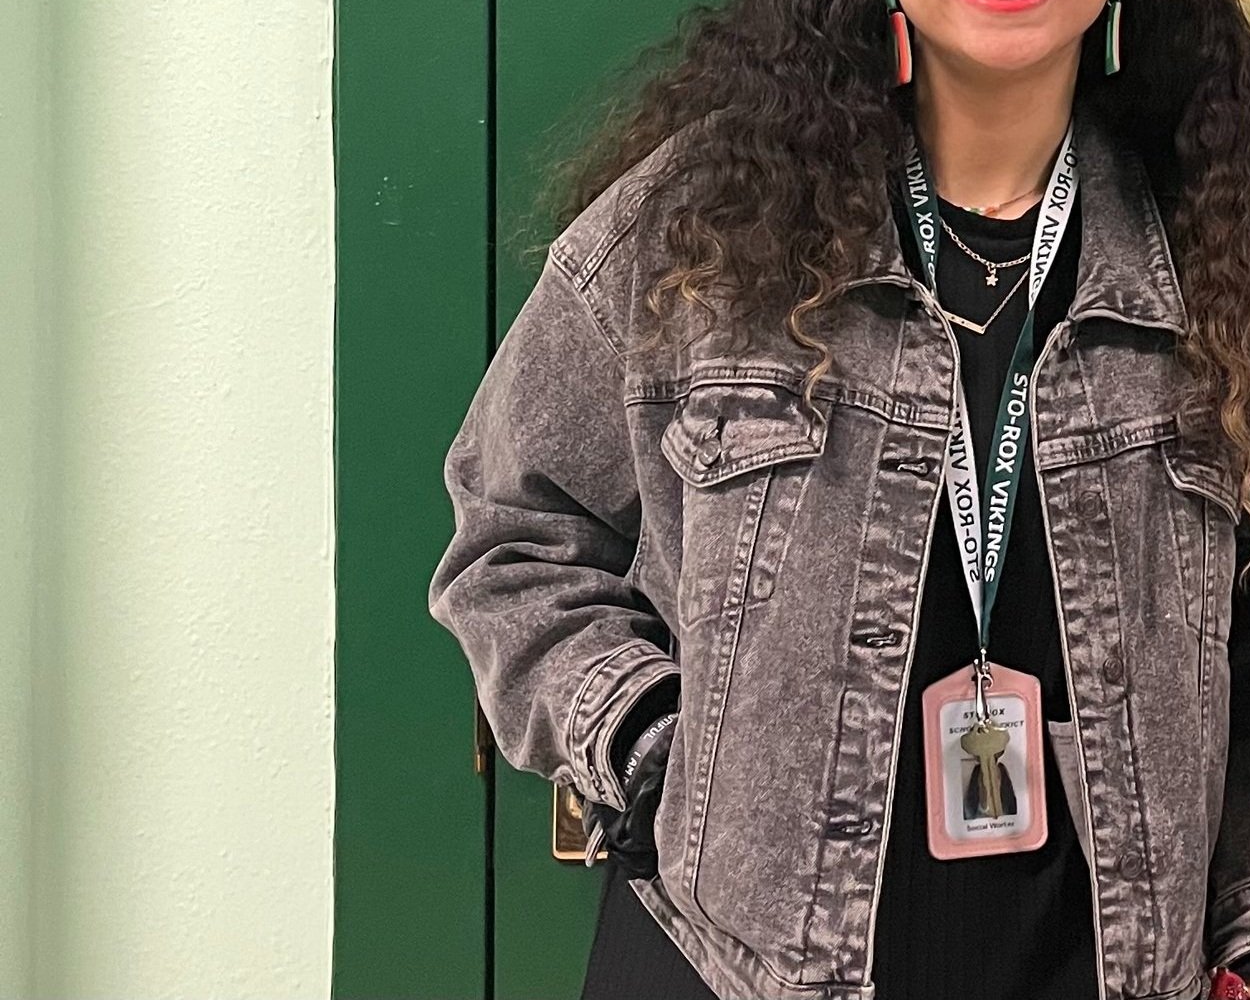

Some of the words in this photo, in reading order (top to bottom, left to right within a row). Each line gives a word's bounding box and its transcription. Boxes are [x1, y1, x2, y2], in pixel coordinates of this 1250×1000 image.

[916, 211, 936, 284] O-ROX
[995, 372, 1028, 474] STO-ROX
[984, 480, 1011, 582] VIKINGS
[643, 713, 678, 739] UTIFUL
[963, 707, 1006, 719] STOX
